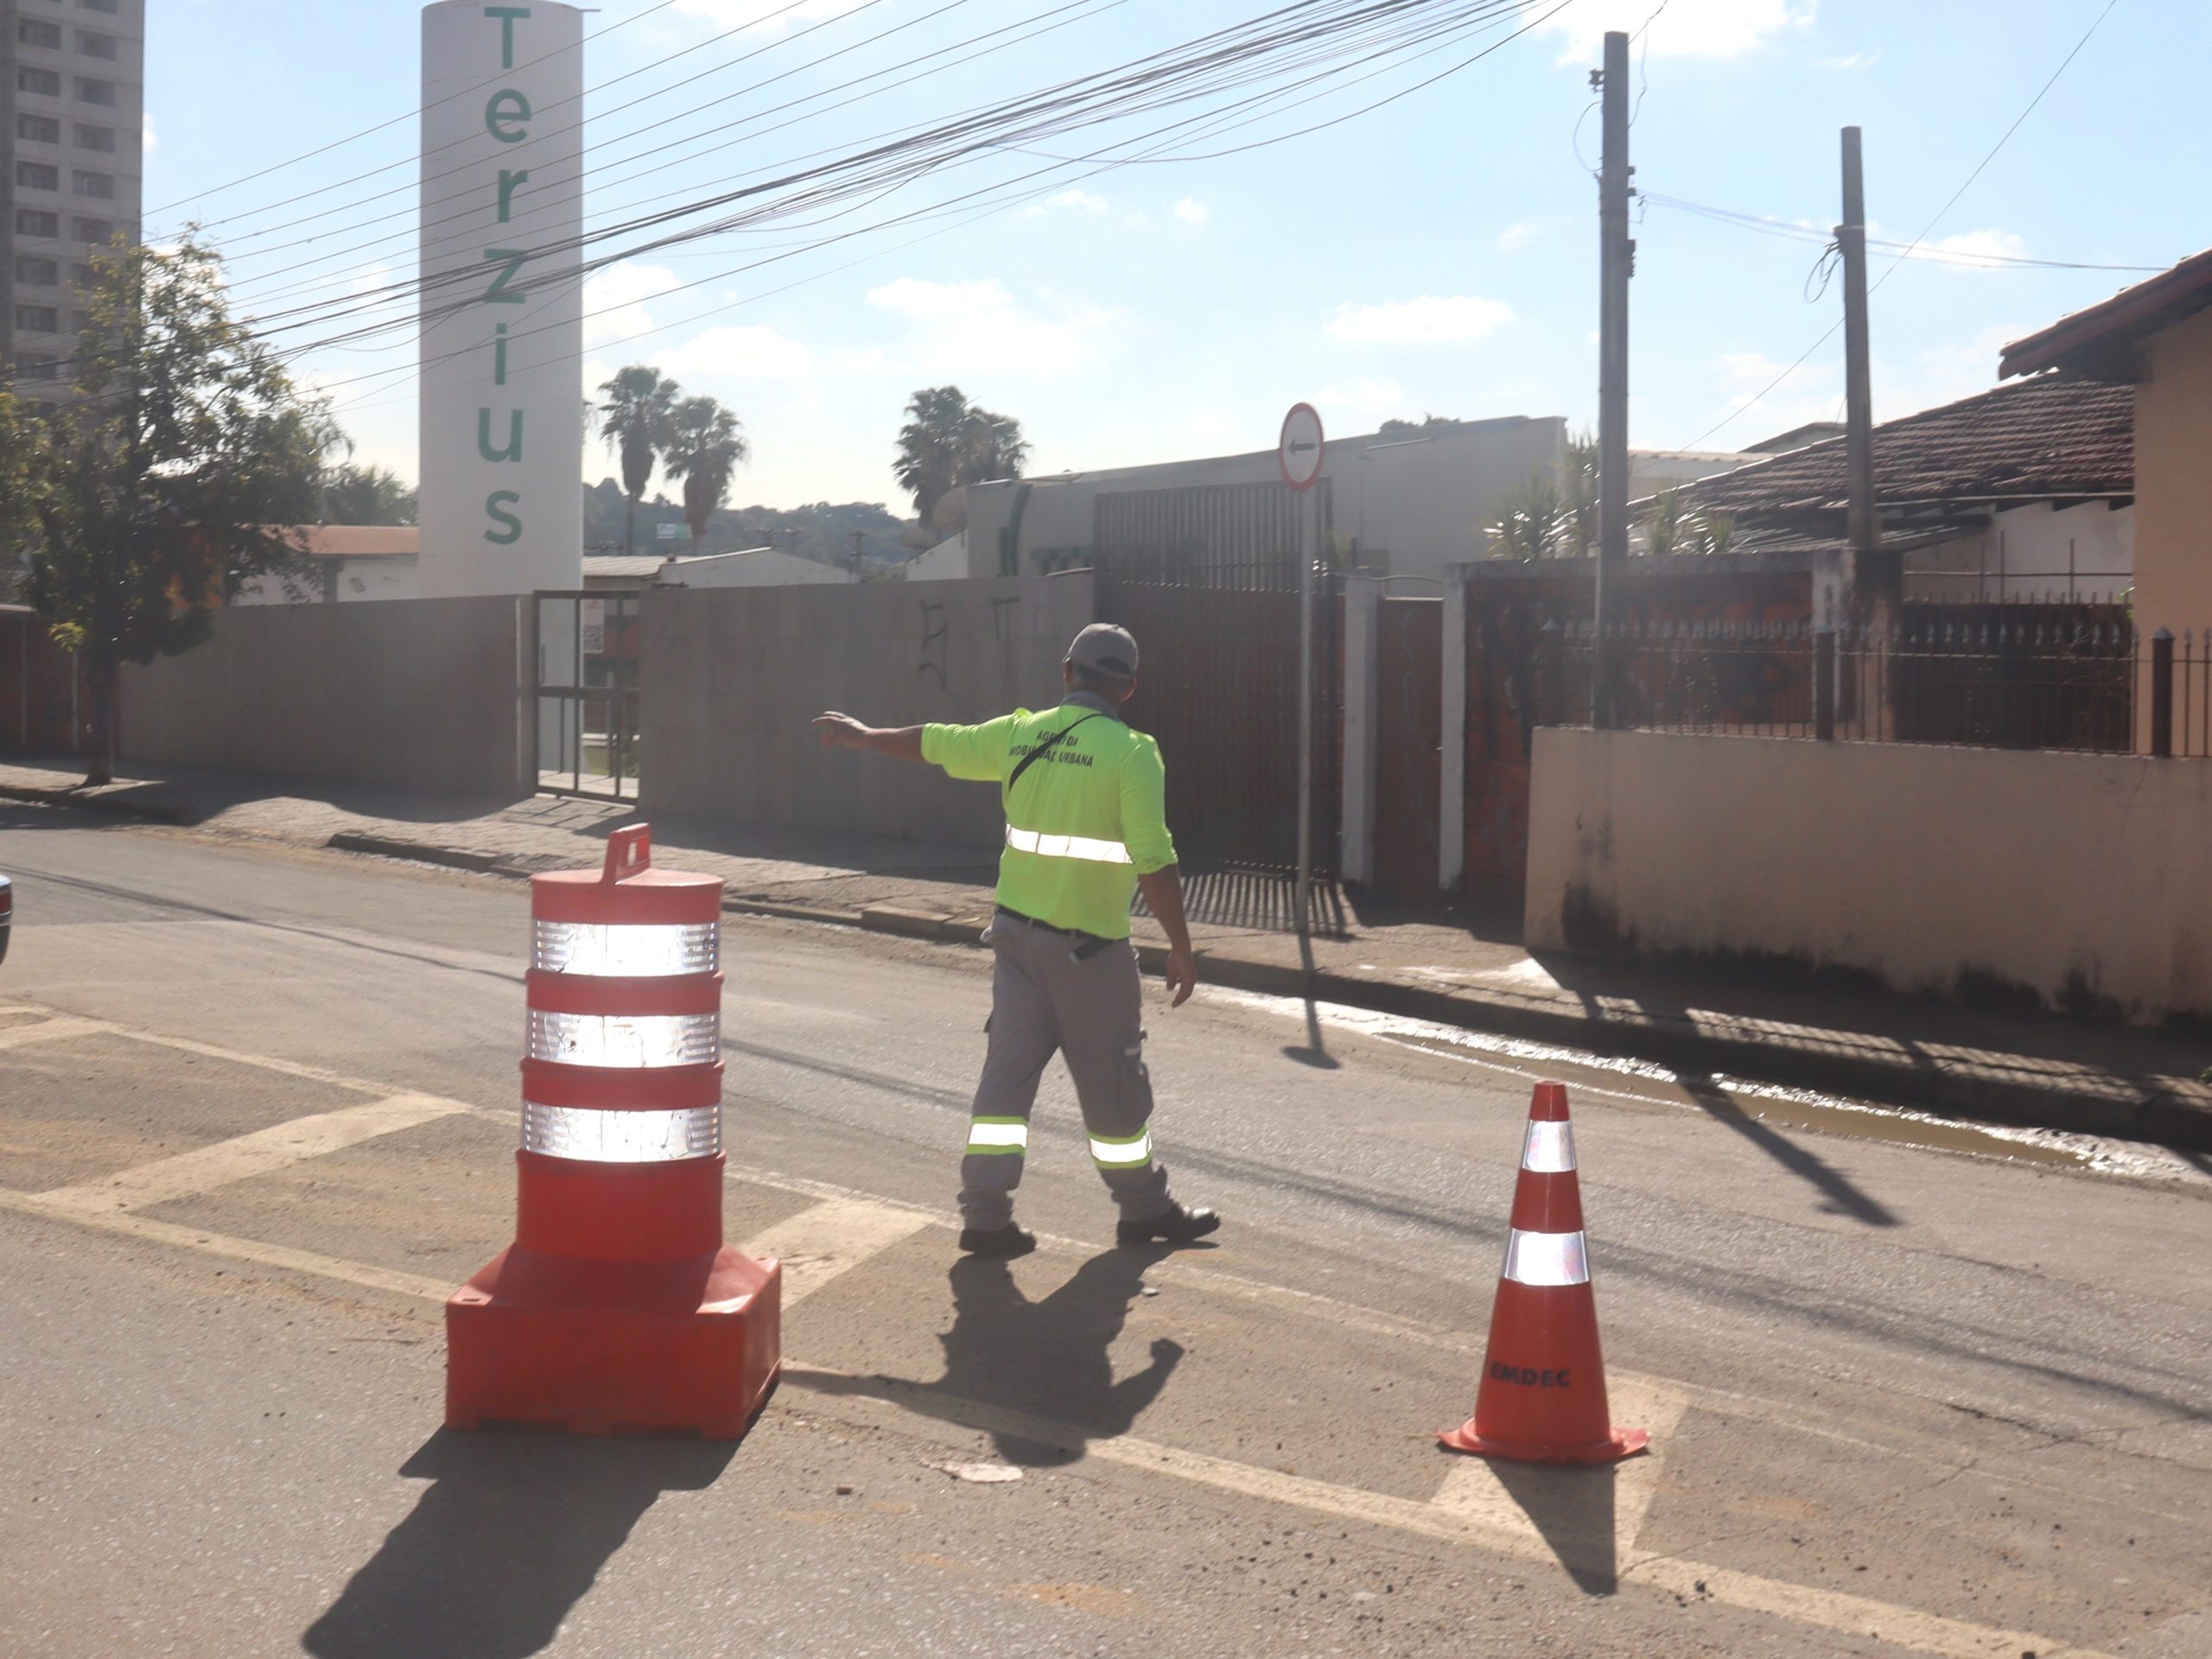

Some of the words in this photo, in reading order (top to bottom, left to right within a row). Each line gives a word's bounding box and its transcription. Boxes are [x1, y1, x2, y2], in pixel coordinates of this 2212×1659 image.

[477, 6, 531, 545] Terzius
[1058, 752, 1094, 767] URBANA
[1491, 1360, 1571, 1388] EMDEC
